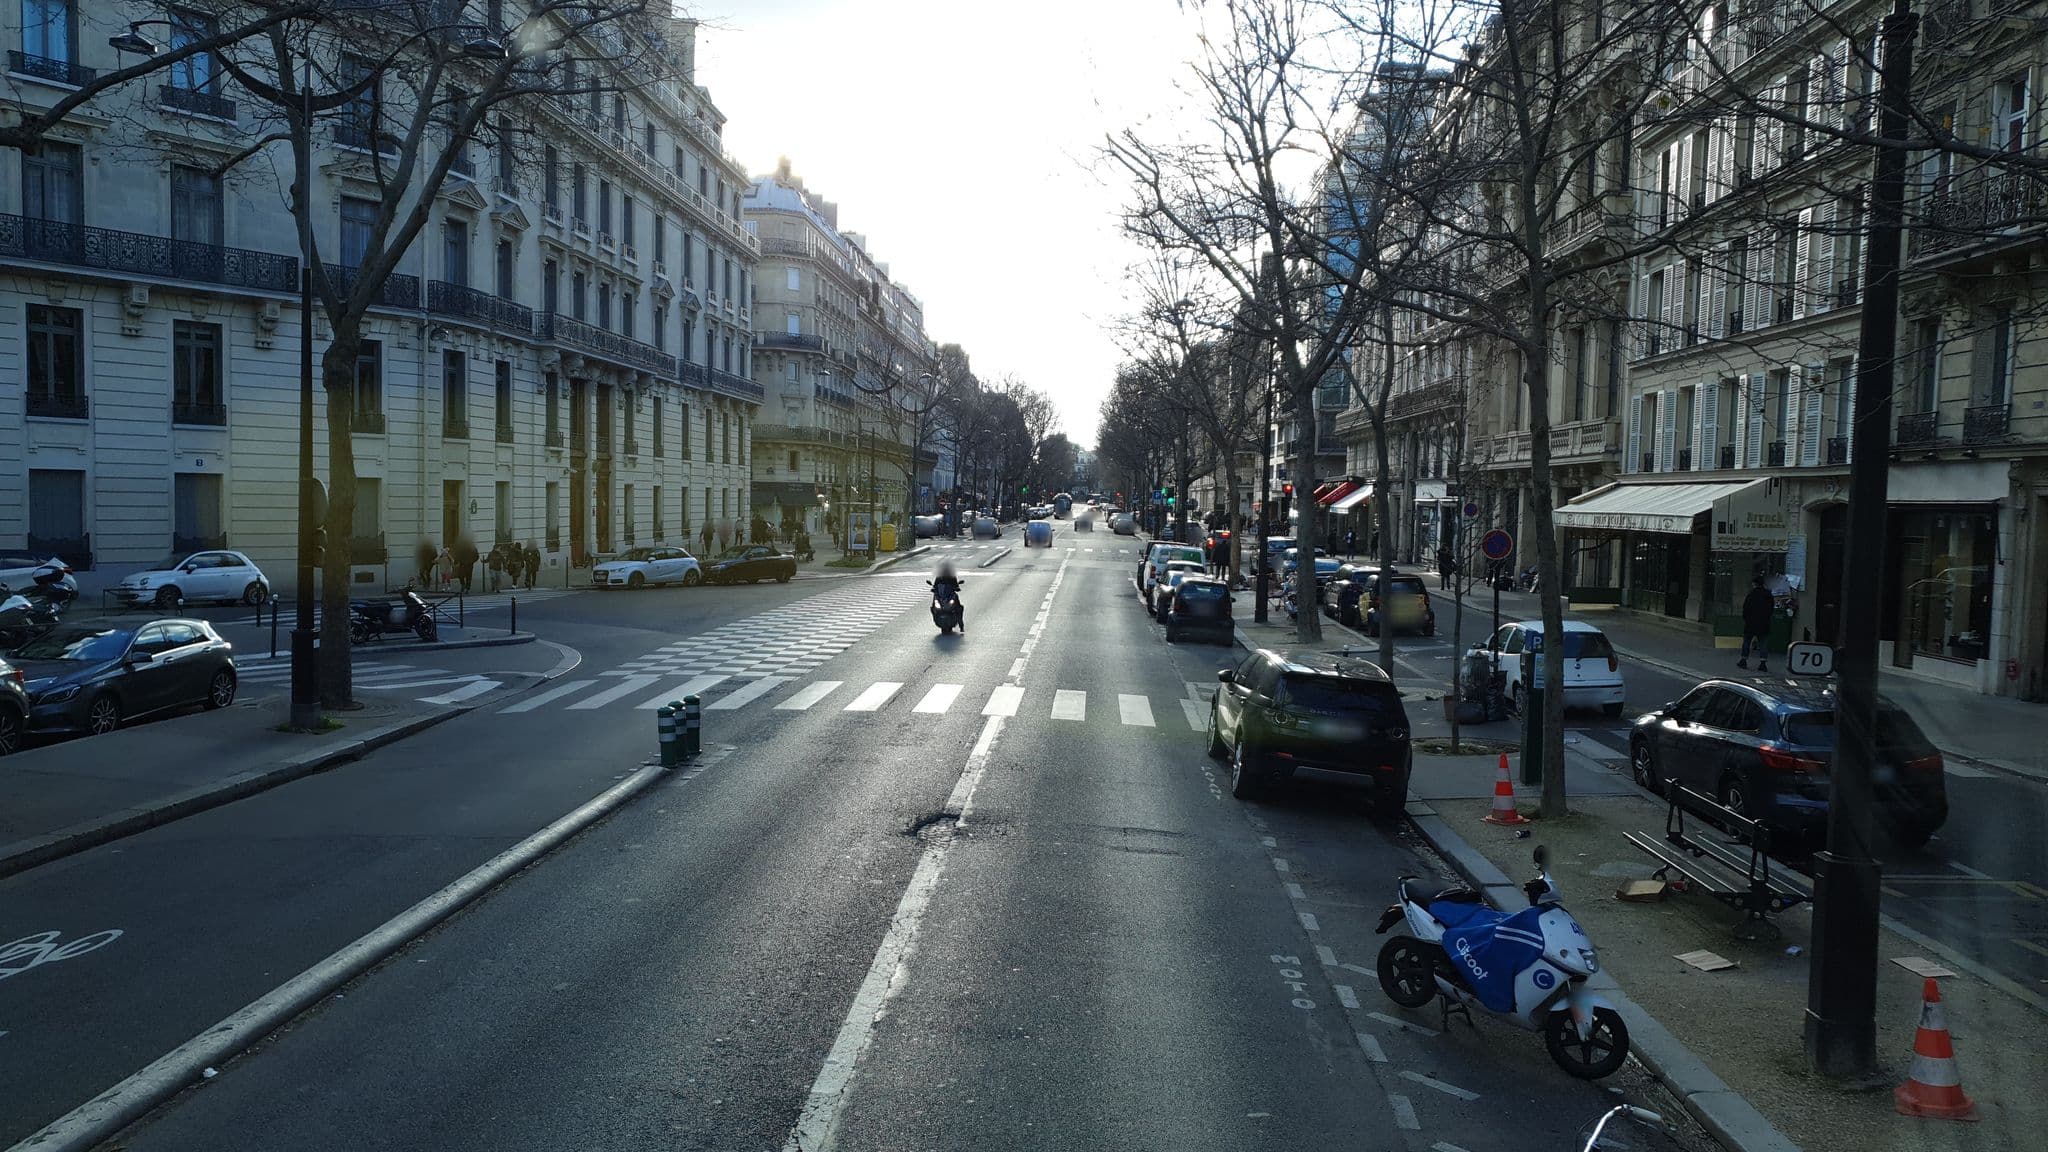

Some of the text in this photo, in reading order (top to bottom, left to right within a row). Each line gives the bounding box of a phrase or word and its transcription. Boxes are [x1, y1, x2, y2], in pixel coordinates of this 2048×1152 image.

[1533, 636, 1542, 649] P
[1799, 651, 1823, 667] 70
[1270, 954, 1317, 1010] MOTO
